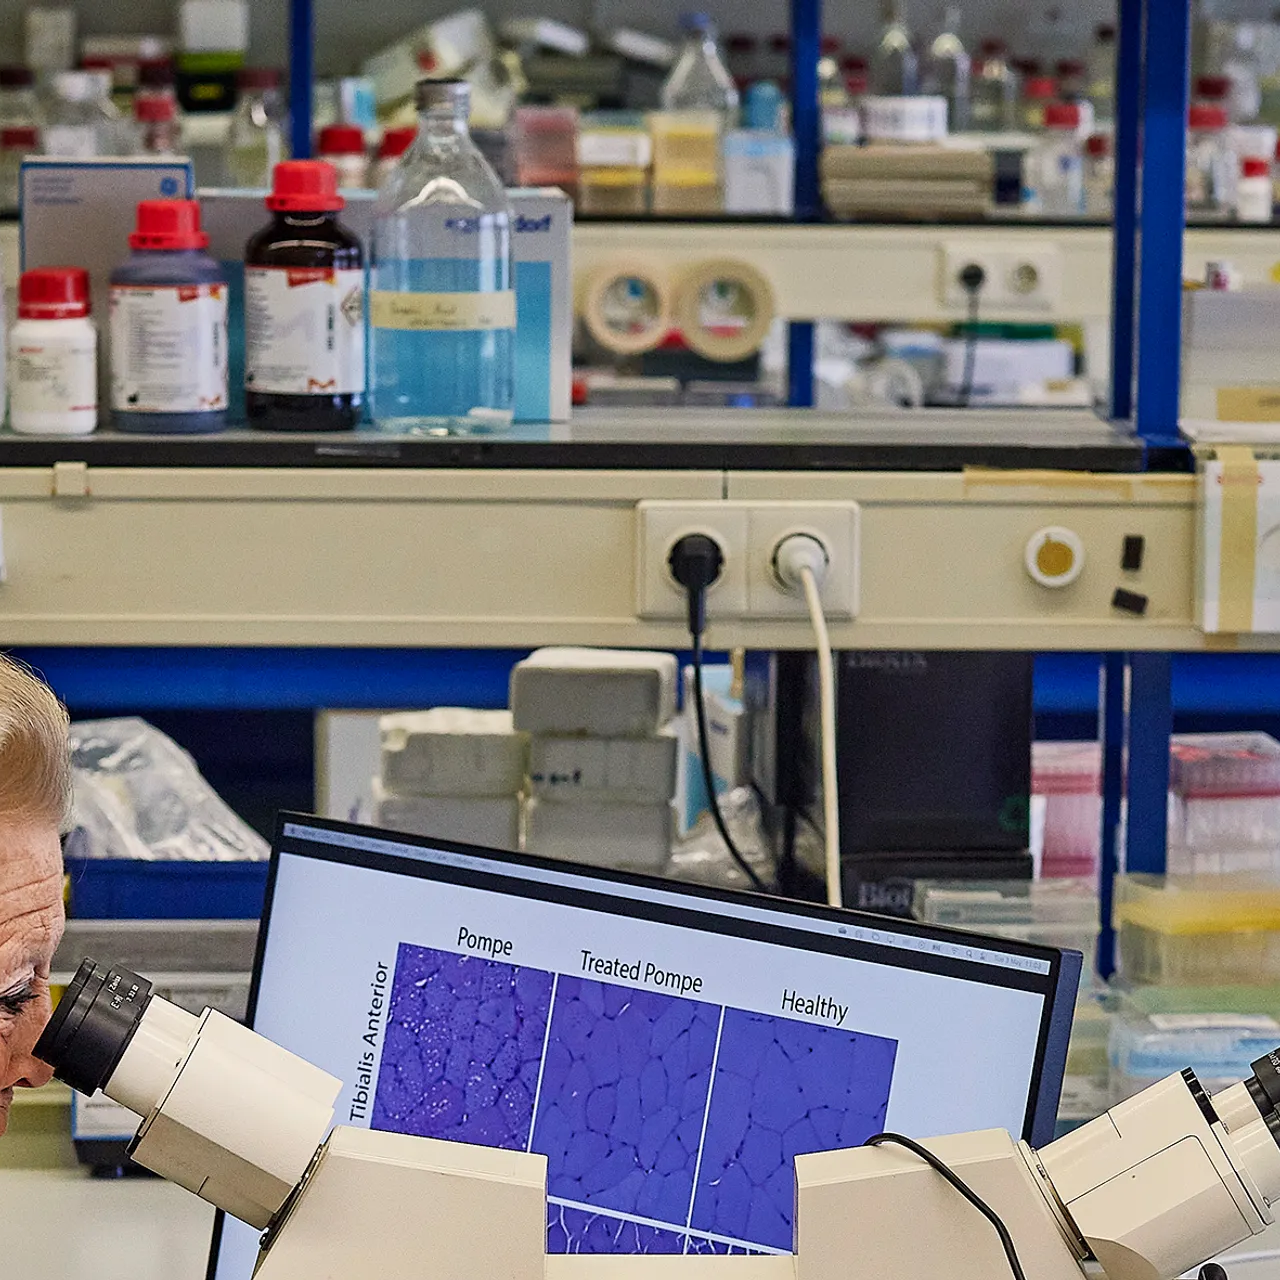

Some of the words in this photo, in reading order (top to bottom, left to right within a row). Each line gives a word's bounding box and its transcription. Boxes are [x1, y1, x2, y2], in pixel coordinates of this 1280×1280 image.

[457, 926, 513, 958] Pompe
[581, 949, 642, 981] Treated
[644, 962, 703, 995] Pompe
[781, 988, 848, 1027] Healthy
[349, 1051, 375, 1122] Tibialis
[362, 961, 389, 1047] Anterior
